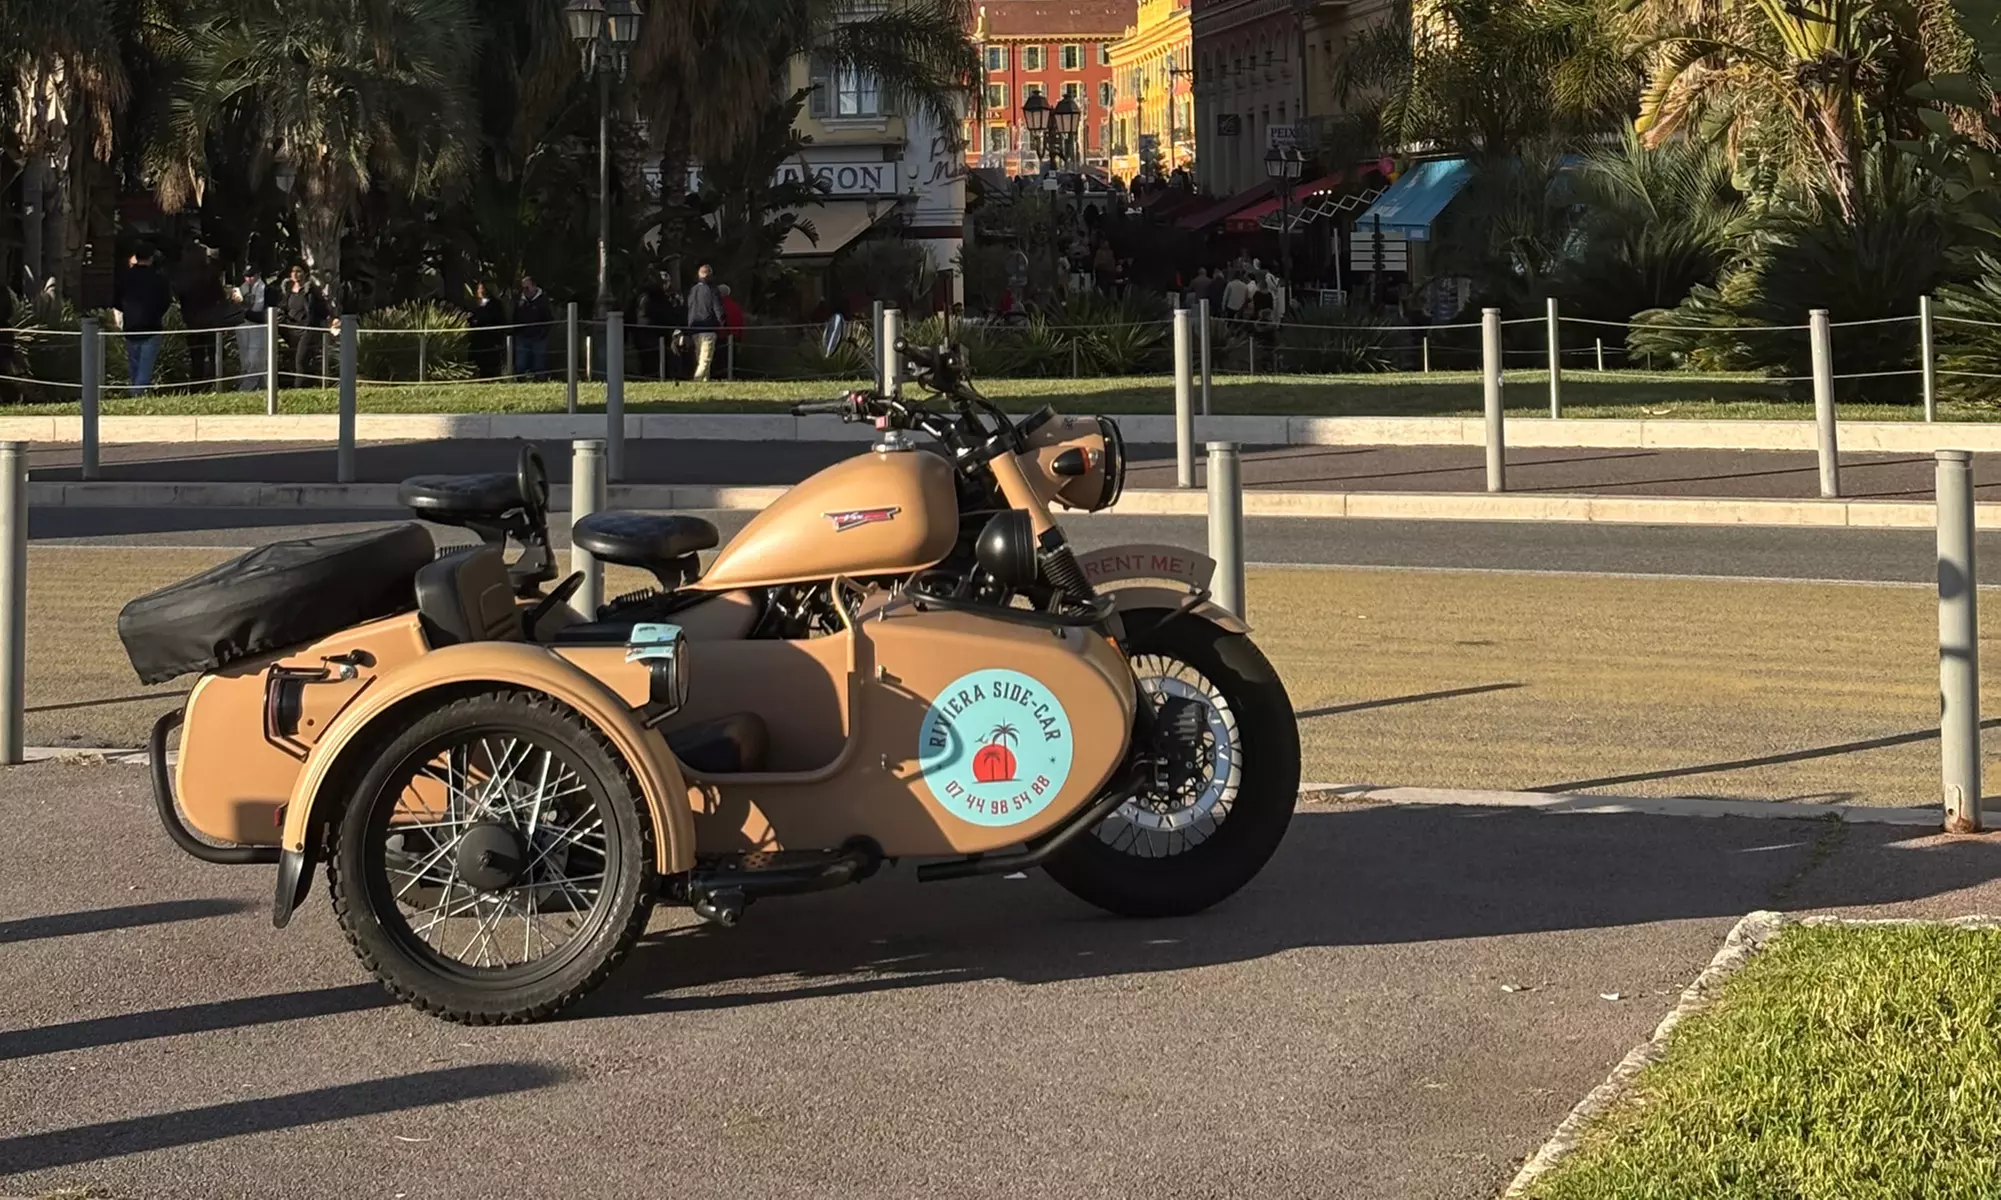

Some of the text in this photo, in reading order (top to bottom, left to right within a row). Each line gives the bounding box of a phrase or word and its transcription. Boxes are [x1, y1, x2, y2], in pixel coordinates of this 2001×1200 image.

[1084, 555, 1144, 577] RENT
[1151, 555, 1184, 573] ME
[929, 681, 1061, 748] RIVIERA SIDE-CAR
[945, 775, 1051, 815] 07 44 98 54 88
